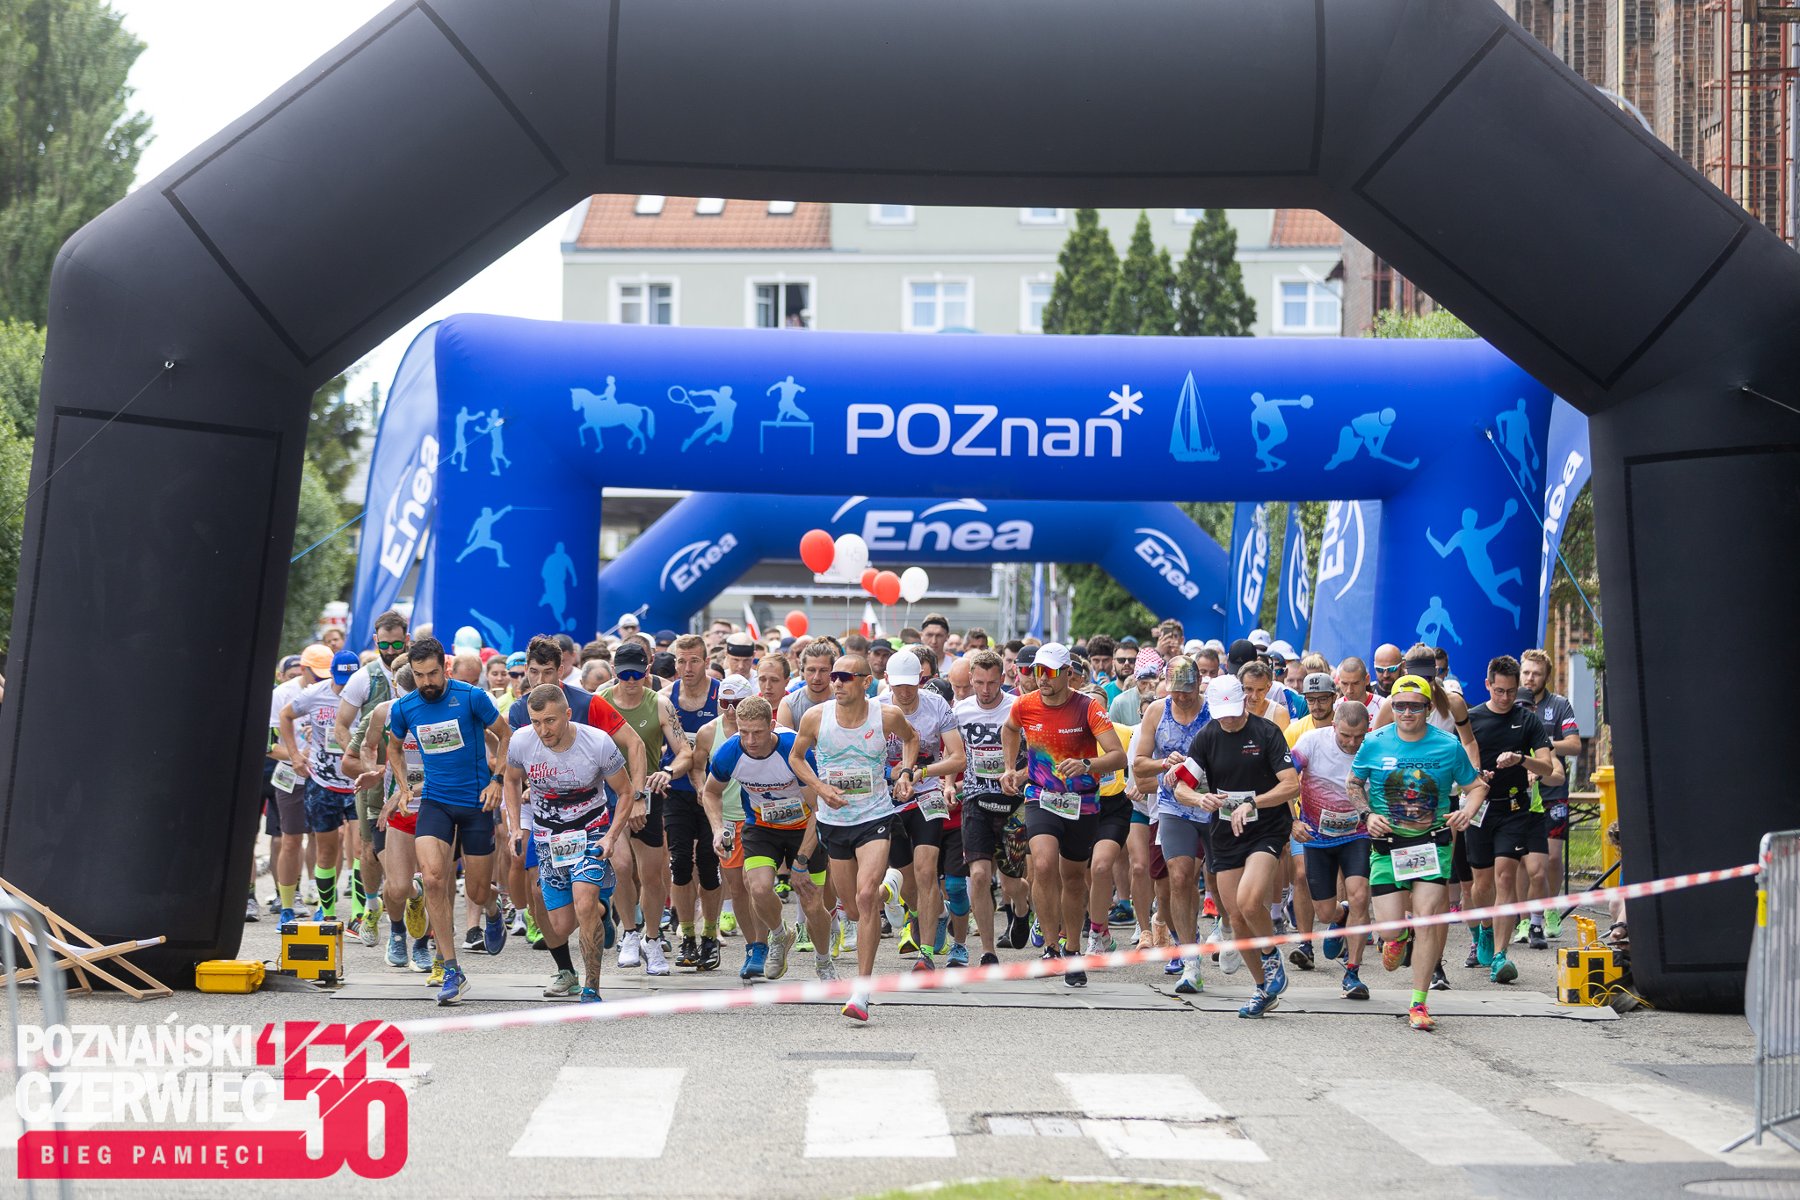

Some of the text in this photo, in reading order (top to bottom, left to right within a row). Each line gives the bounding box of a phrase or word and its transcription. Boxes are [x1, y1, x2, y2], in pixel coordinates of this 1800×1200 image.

[380, 434, 440, 579] Enea
[862, 510, 1034, 551] Enea
[670, 532, 738, 592] Enea
[1134, 537, 1200, 600] Enea
[430, 732, 451, 745] 252
[983, 760, 999, 770] 120
[1397, 762, 1441, 770] CROSS
[837, 779, 863, 790] 1212
[1051, 797, 1070, 809] 416
[767, 808, 793, 821] 1228
[553, 842, 577, 855] 1227
[1406, 856, 1427, 868] 473
